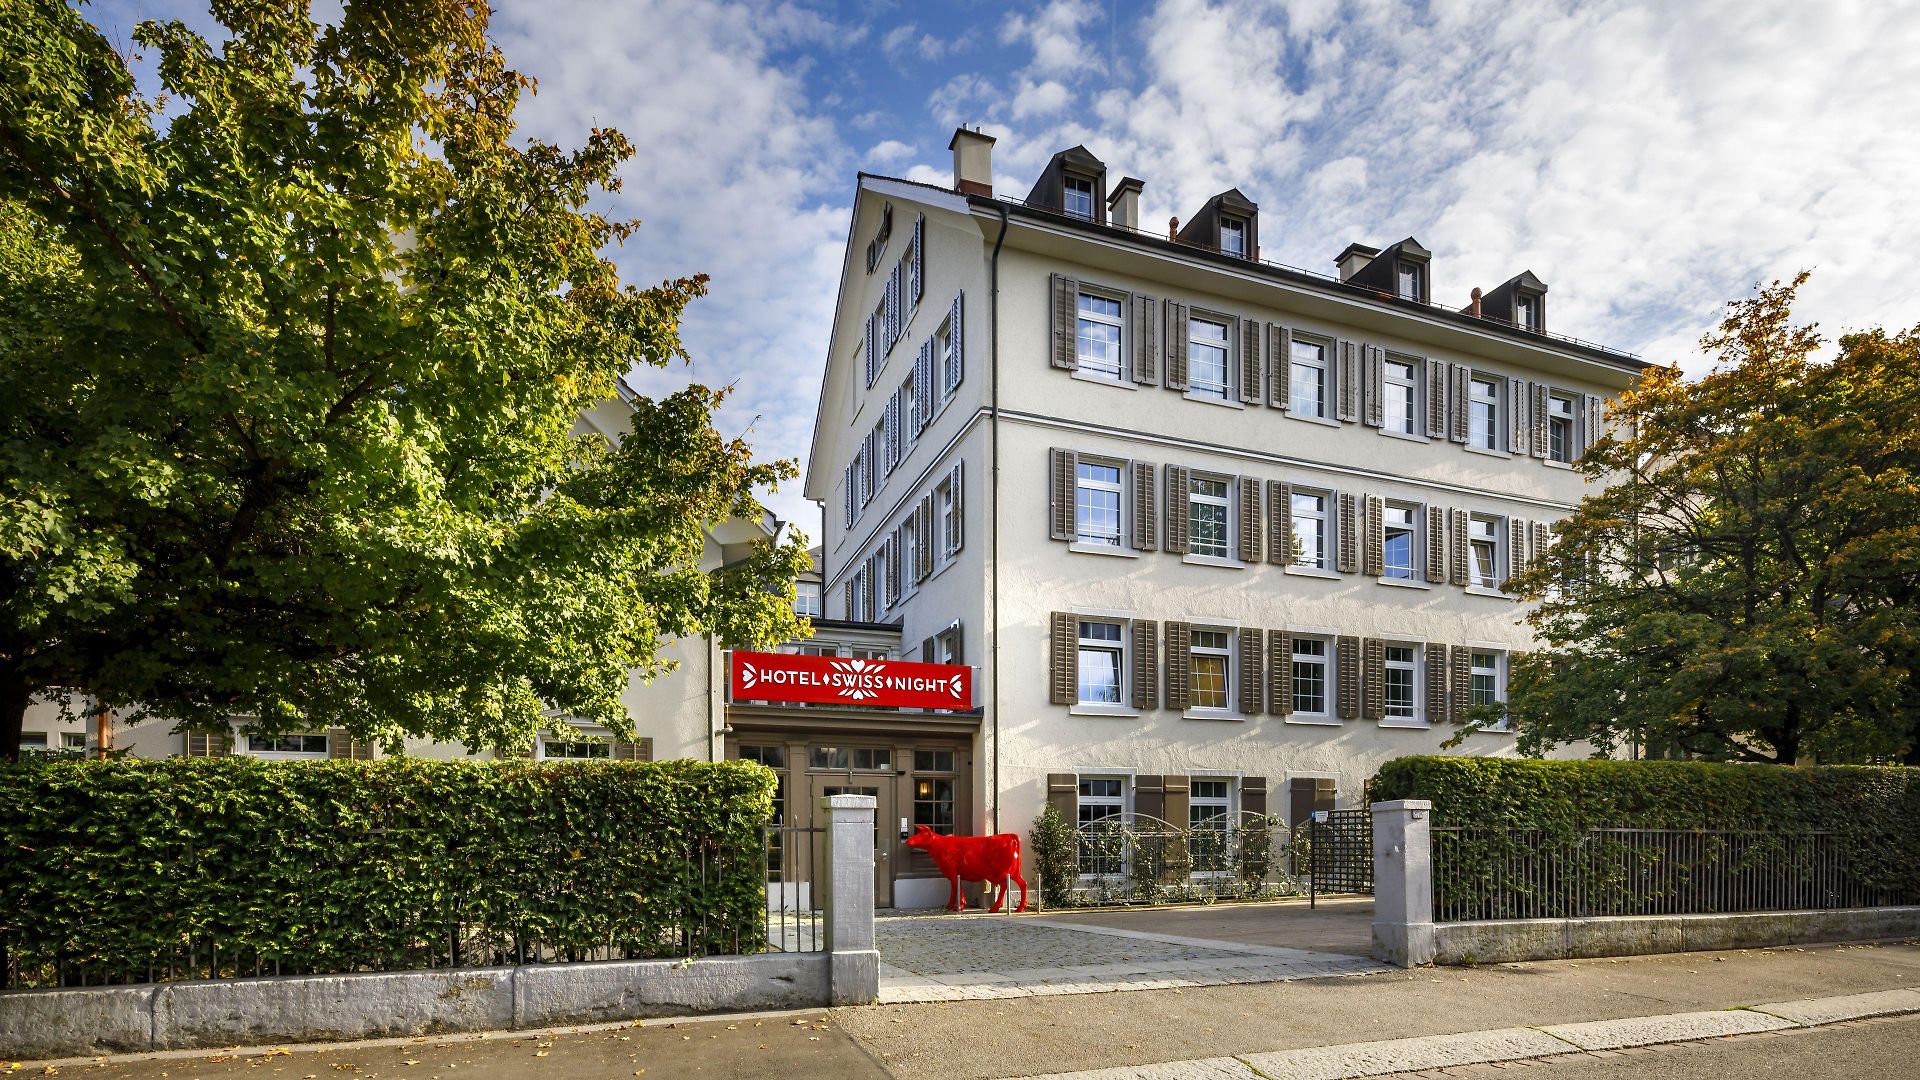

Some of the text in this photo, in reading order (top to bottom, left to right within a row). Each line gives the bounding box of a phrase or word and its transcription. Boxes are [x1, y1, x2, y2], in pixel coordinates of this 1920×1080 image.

[760, 669, 947, 692] HOTEL SWISS NIGHT
